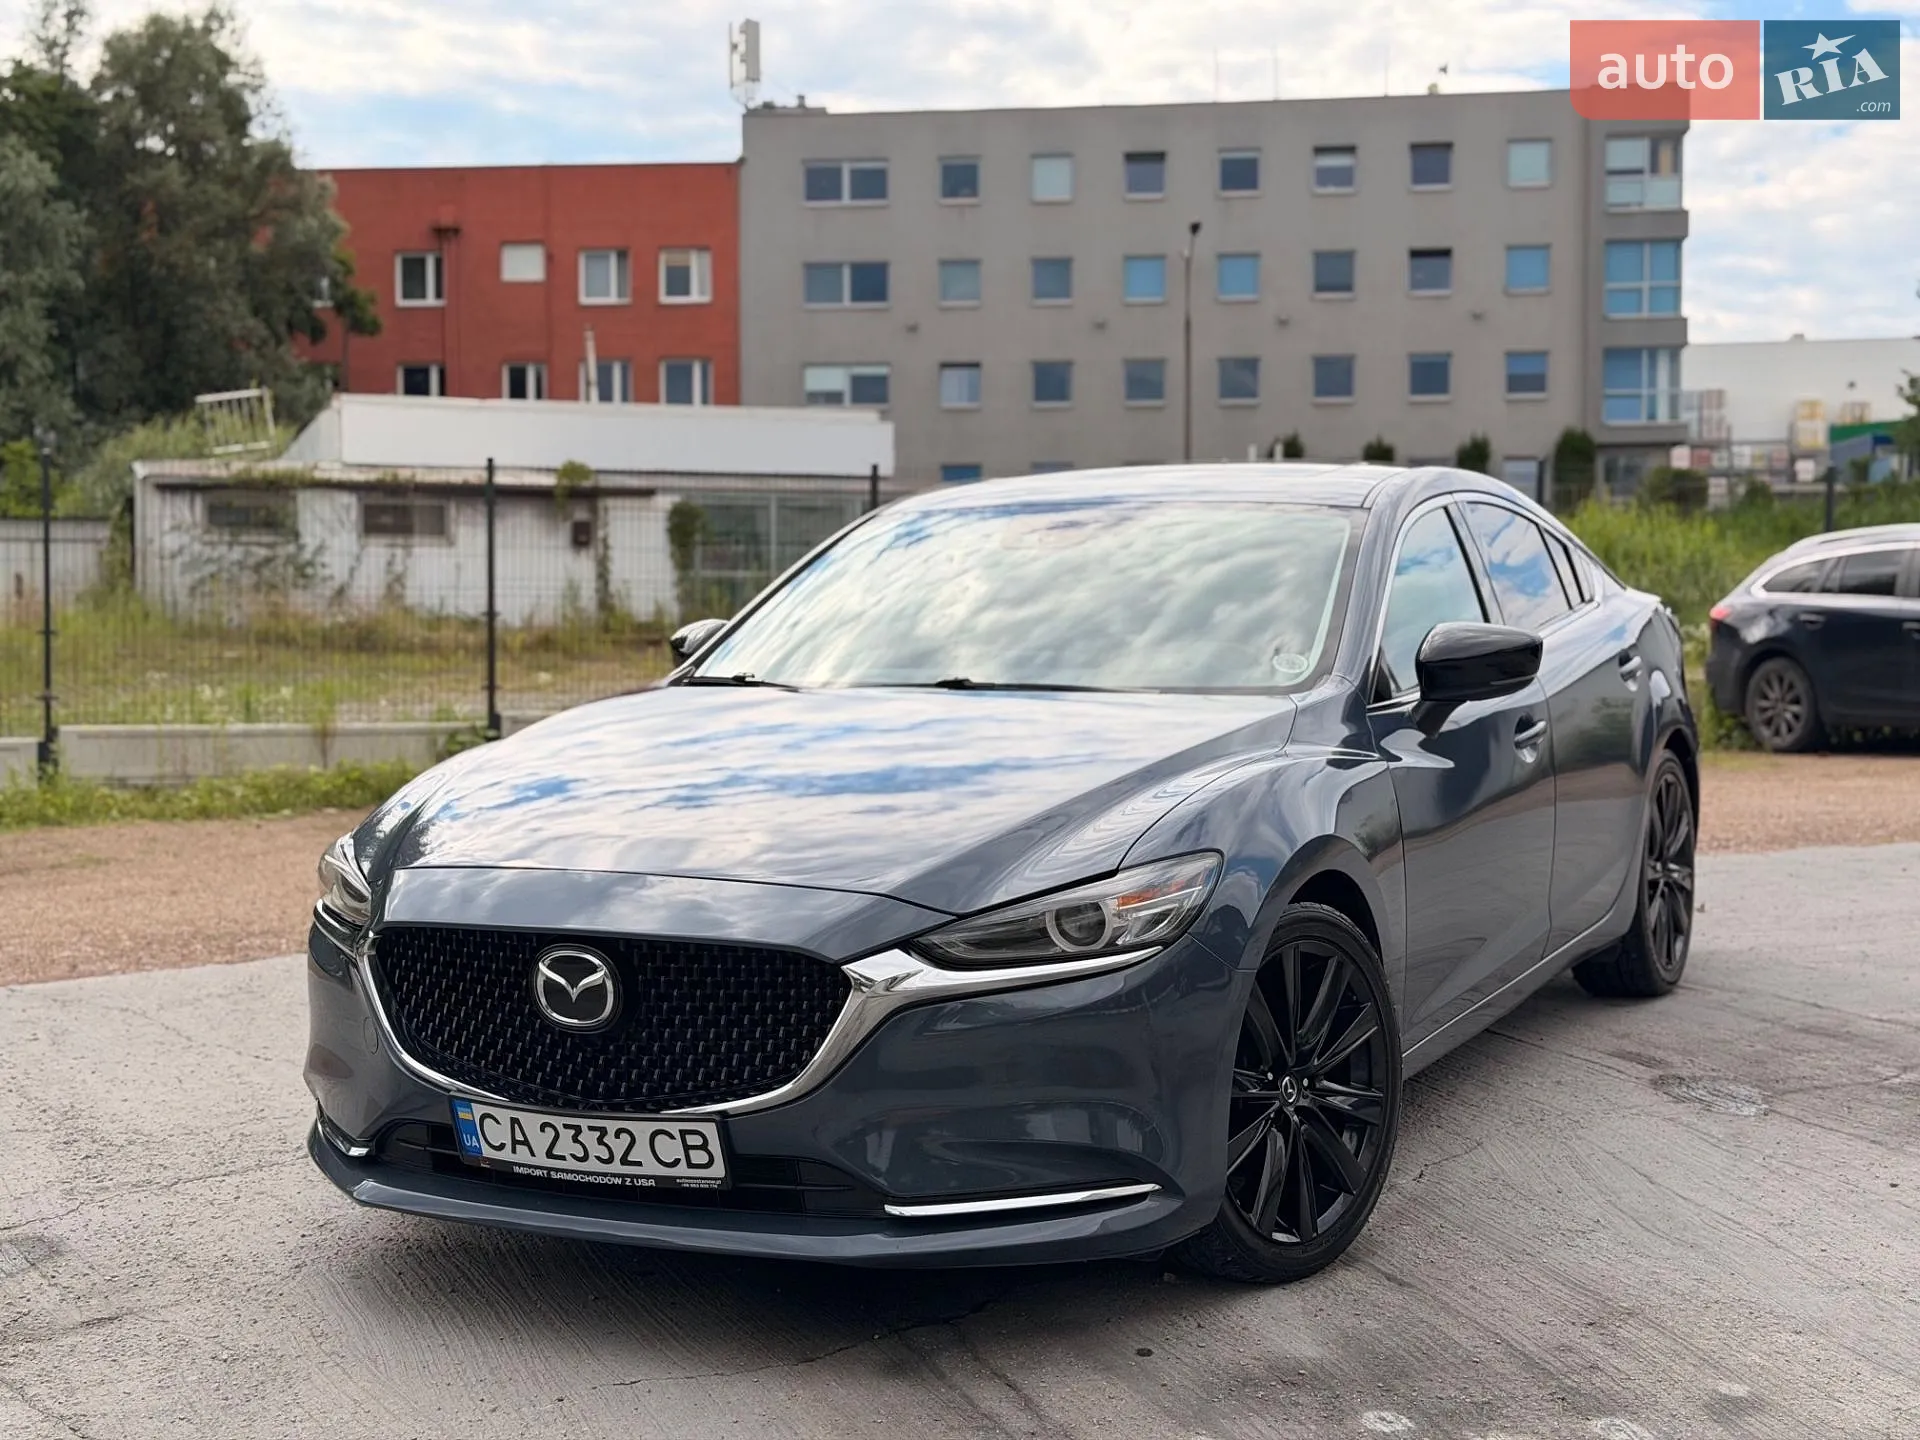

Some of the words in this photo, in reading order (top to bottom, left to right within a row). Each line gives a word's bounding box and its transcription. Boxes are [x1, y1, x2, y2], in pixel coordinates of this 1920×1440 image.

[463, 1133, 480, 1148] UA
[539, 1121, 643, 1168] 2332
[513, 1165, 548, 1178] IMPORT
[625, 1177, 633, 1186] Z
[634, 1178, 656, 1187] USA
